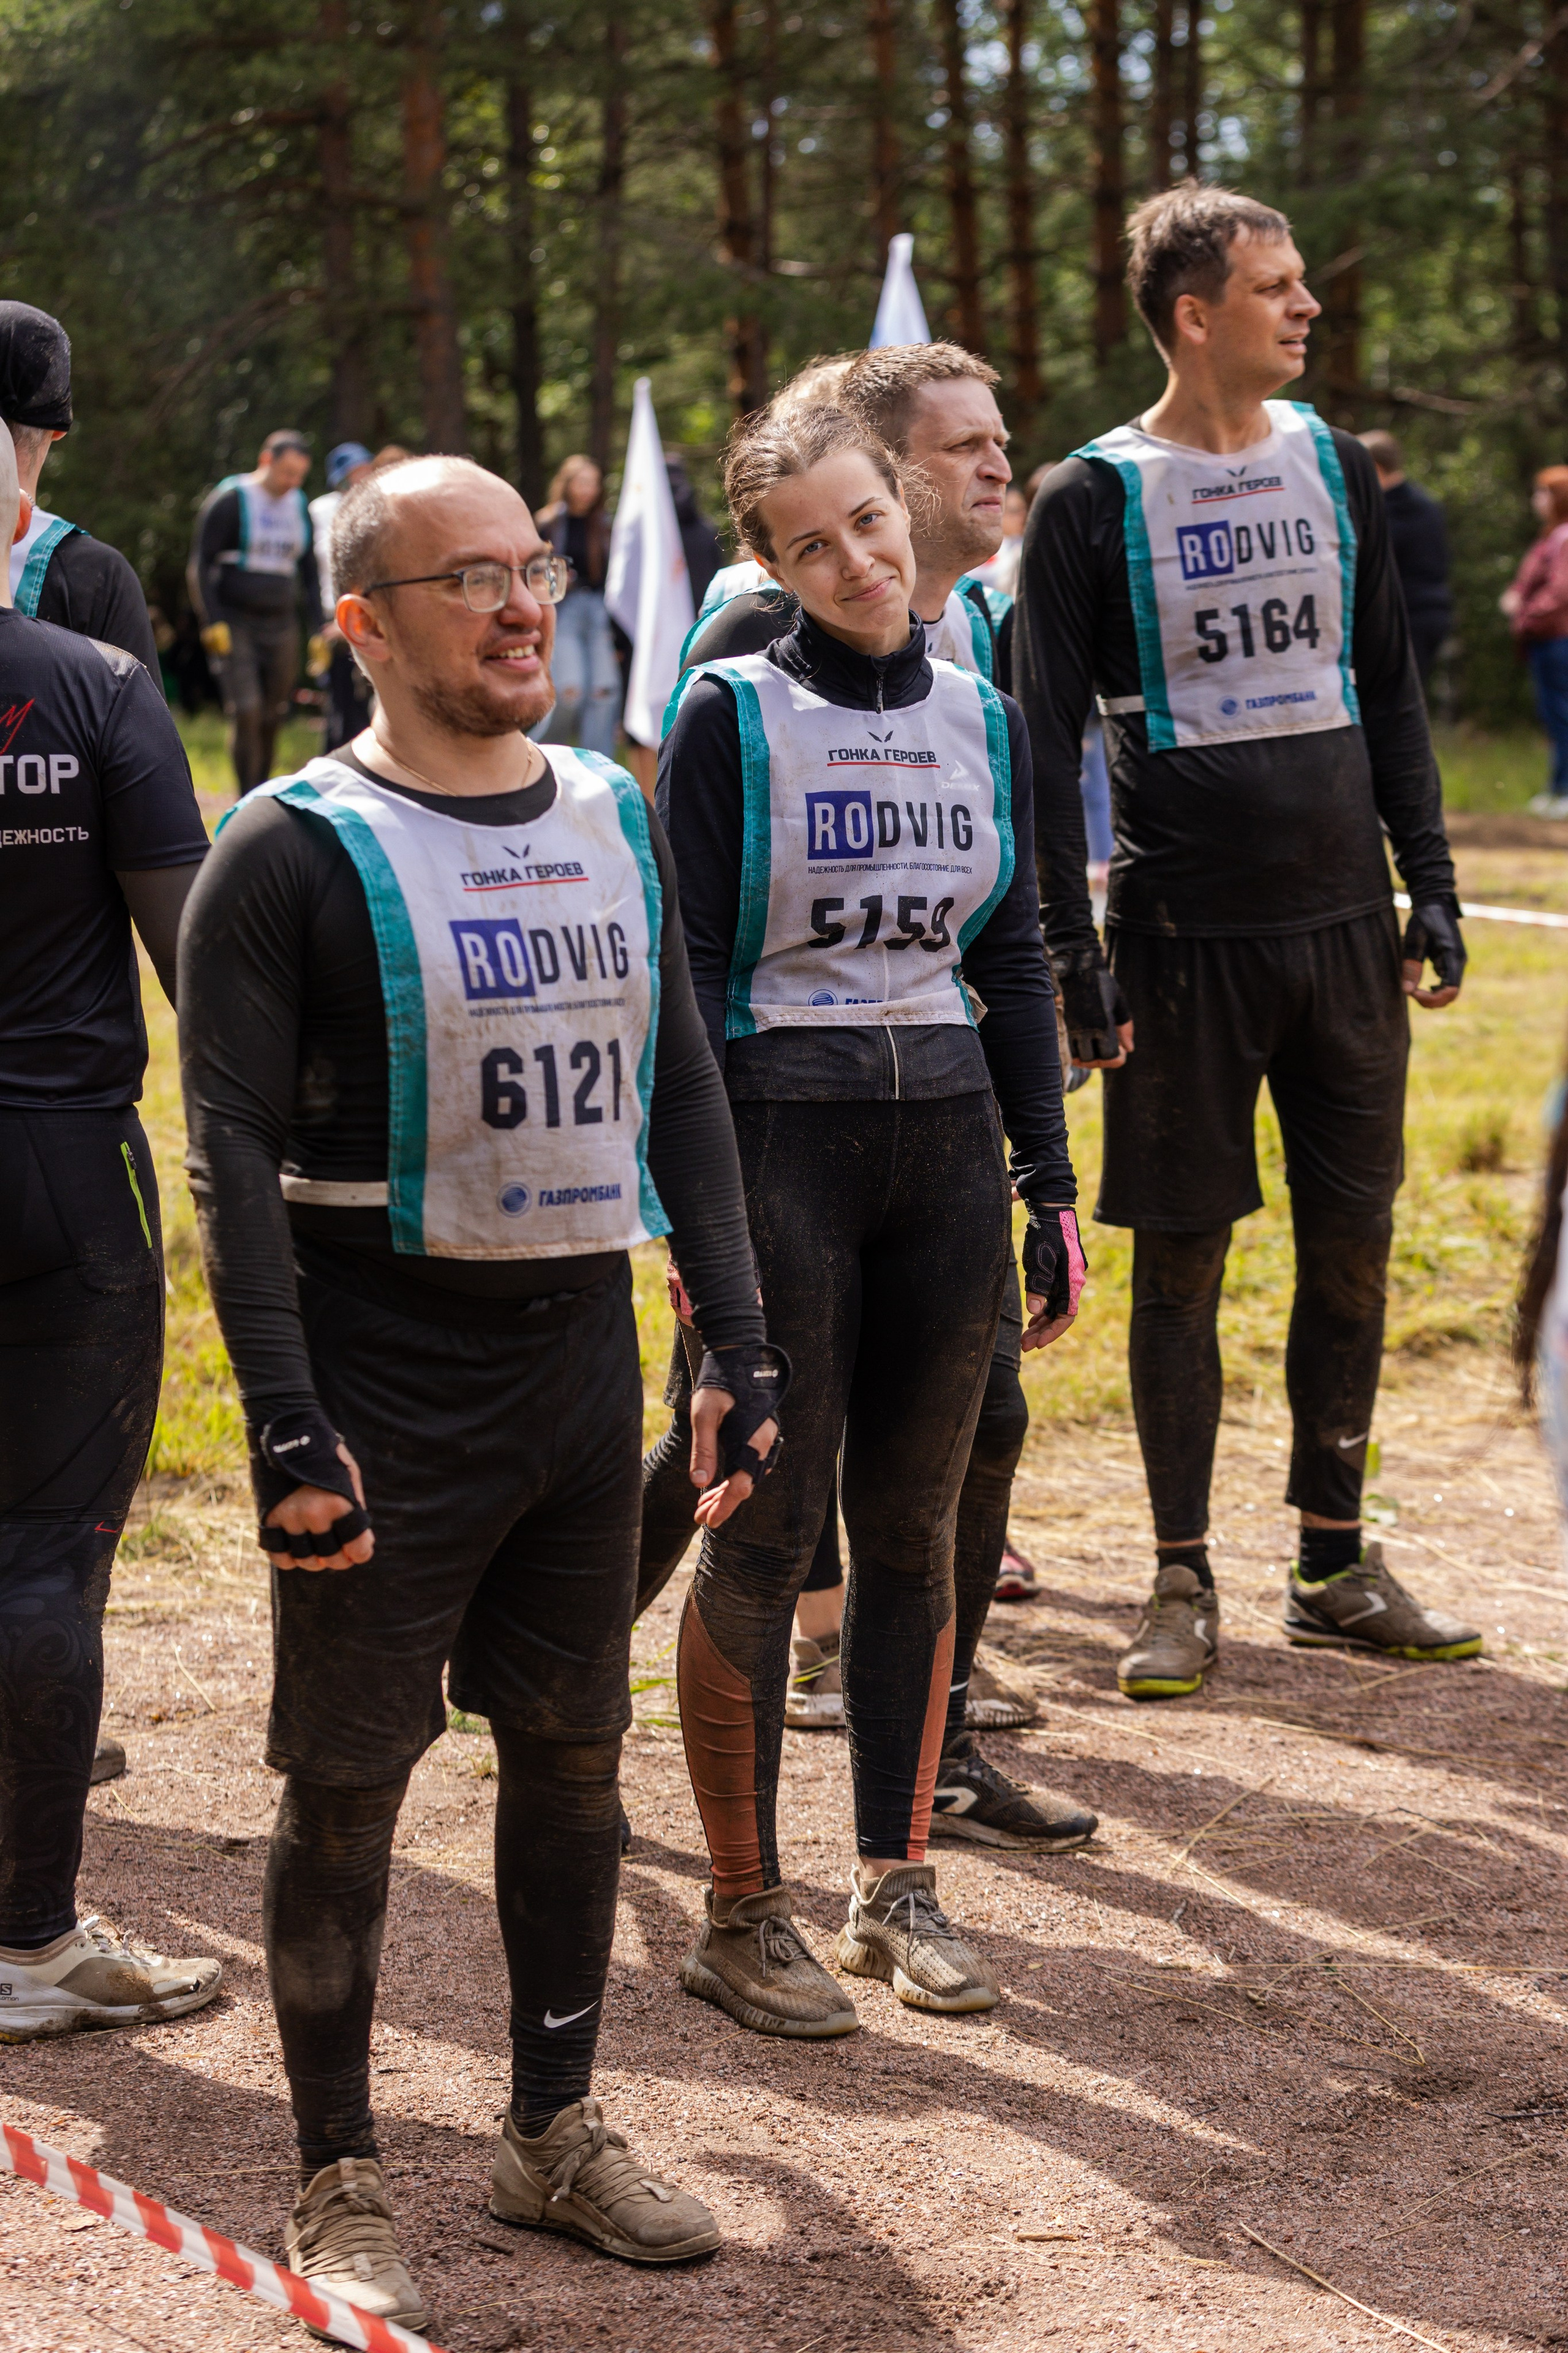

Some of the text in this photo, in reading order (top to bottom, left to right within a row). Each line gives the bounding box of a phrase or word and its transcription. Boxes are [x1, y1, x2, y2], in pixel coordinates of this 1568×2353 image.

[1182, 518, 1315, 574] RODVIG
[1194, 594, 1321, 663] 5164
[828, 749, 937, 763] ГОНКА ГЕРОЕВ
[0, 826, 89, 848] ЕЖНОСТЬ
[814, 800, 973, 852] RODVIG
[461, 861, 584, 886] ГОНКА ГЕРОЕВ
[808, 865, 844, 874] НАДЕЖНОСТЬ
[845, 864, 856, 873] ДЛЯ
[961, 866, 972, 874] ВСЕХ
[807, 894, 955, 953] 5159
[459, 921, 630, 990] RODVIG
[480, 1037, 621, 1129] 6121
[538, 1183, 622, 1207] ГАЗПРОМБАНК
